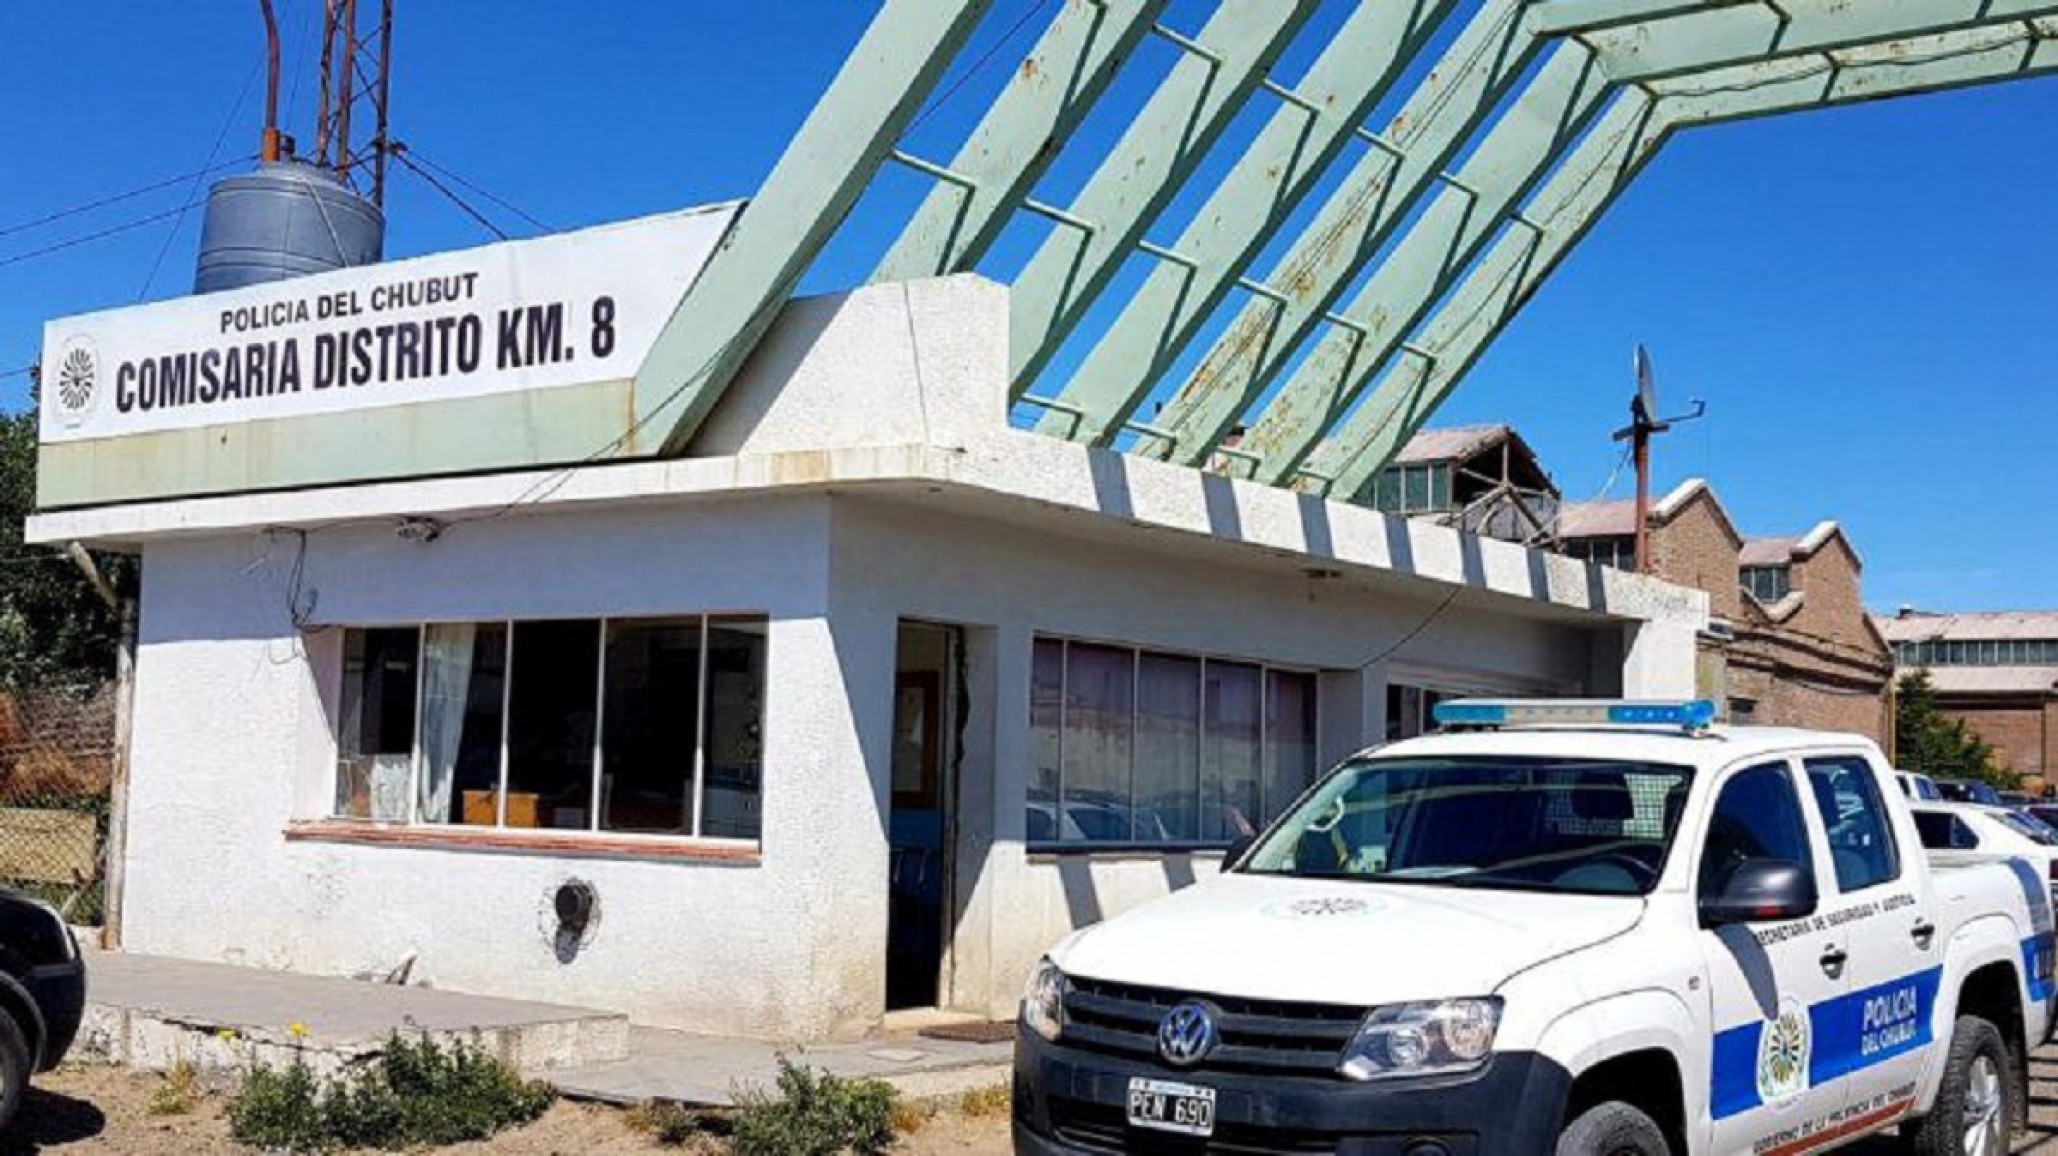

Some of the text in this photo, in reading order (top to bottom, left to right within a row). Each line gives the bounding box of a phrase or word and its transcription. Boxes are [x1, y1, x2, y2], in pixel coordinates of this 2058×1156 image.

[220, 271, 479, 333] POLICIA DEL CHUBUT
[114, 296, 616, 413] COMISARIA DISTRITO KM. 8
[1863, 985, 1916, 1032] POLICIA
[1861, 1022, 1880, 1056] DEL
[1130, 1092, 1211, 1127] PEN 690
